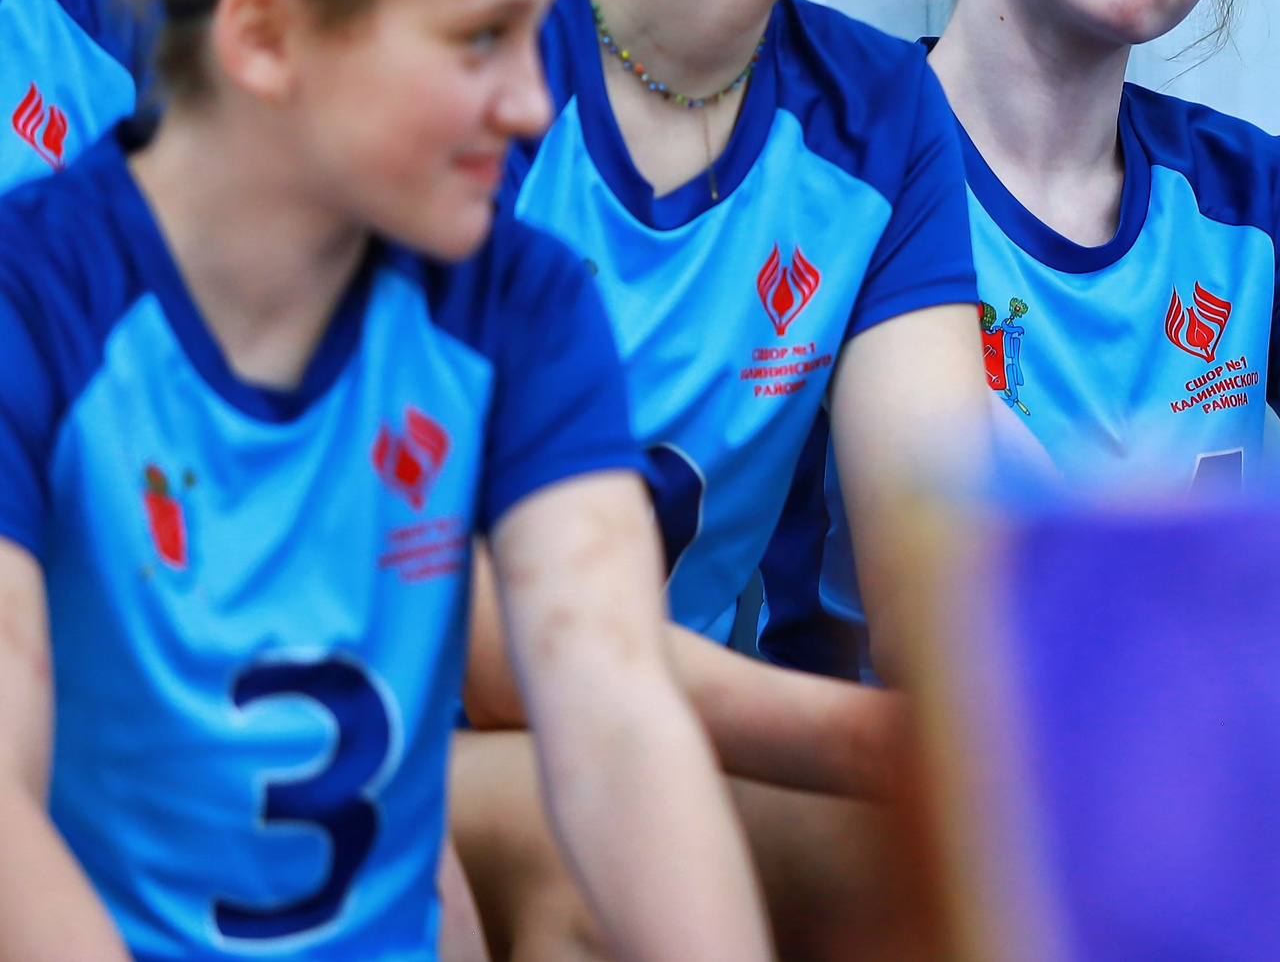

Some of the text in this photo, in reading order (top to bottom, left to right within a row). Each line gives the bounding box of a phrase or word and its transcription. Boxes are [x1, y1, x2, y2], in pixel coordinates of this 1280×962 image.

[1170, 371, 1259, 413] КАЛИНИНСКОГО
[1185, 356, 1248, 392] СШОР №1
[1202, 392, 1248, 414] РАЙОНА
[212, 657, 393, 940] 3
